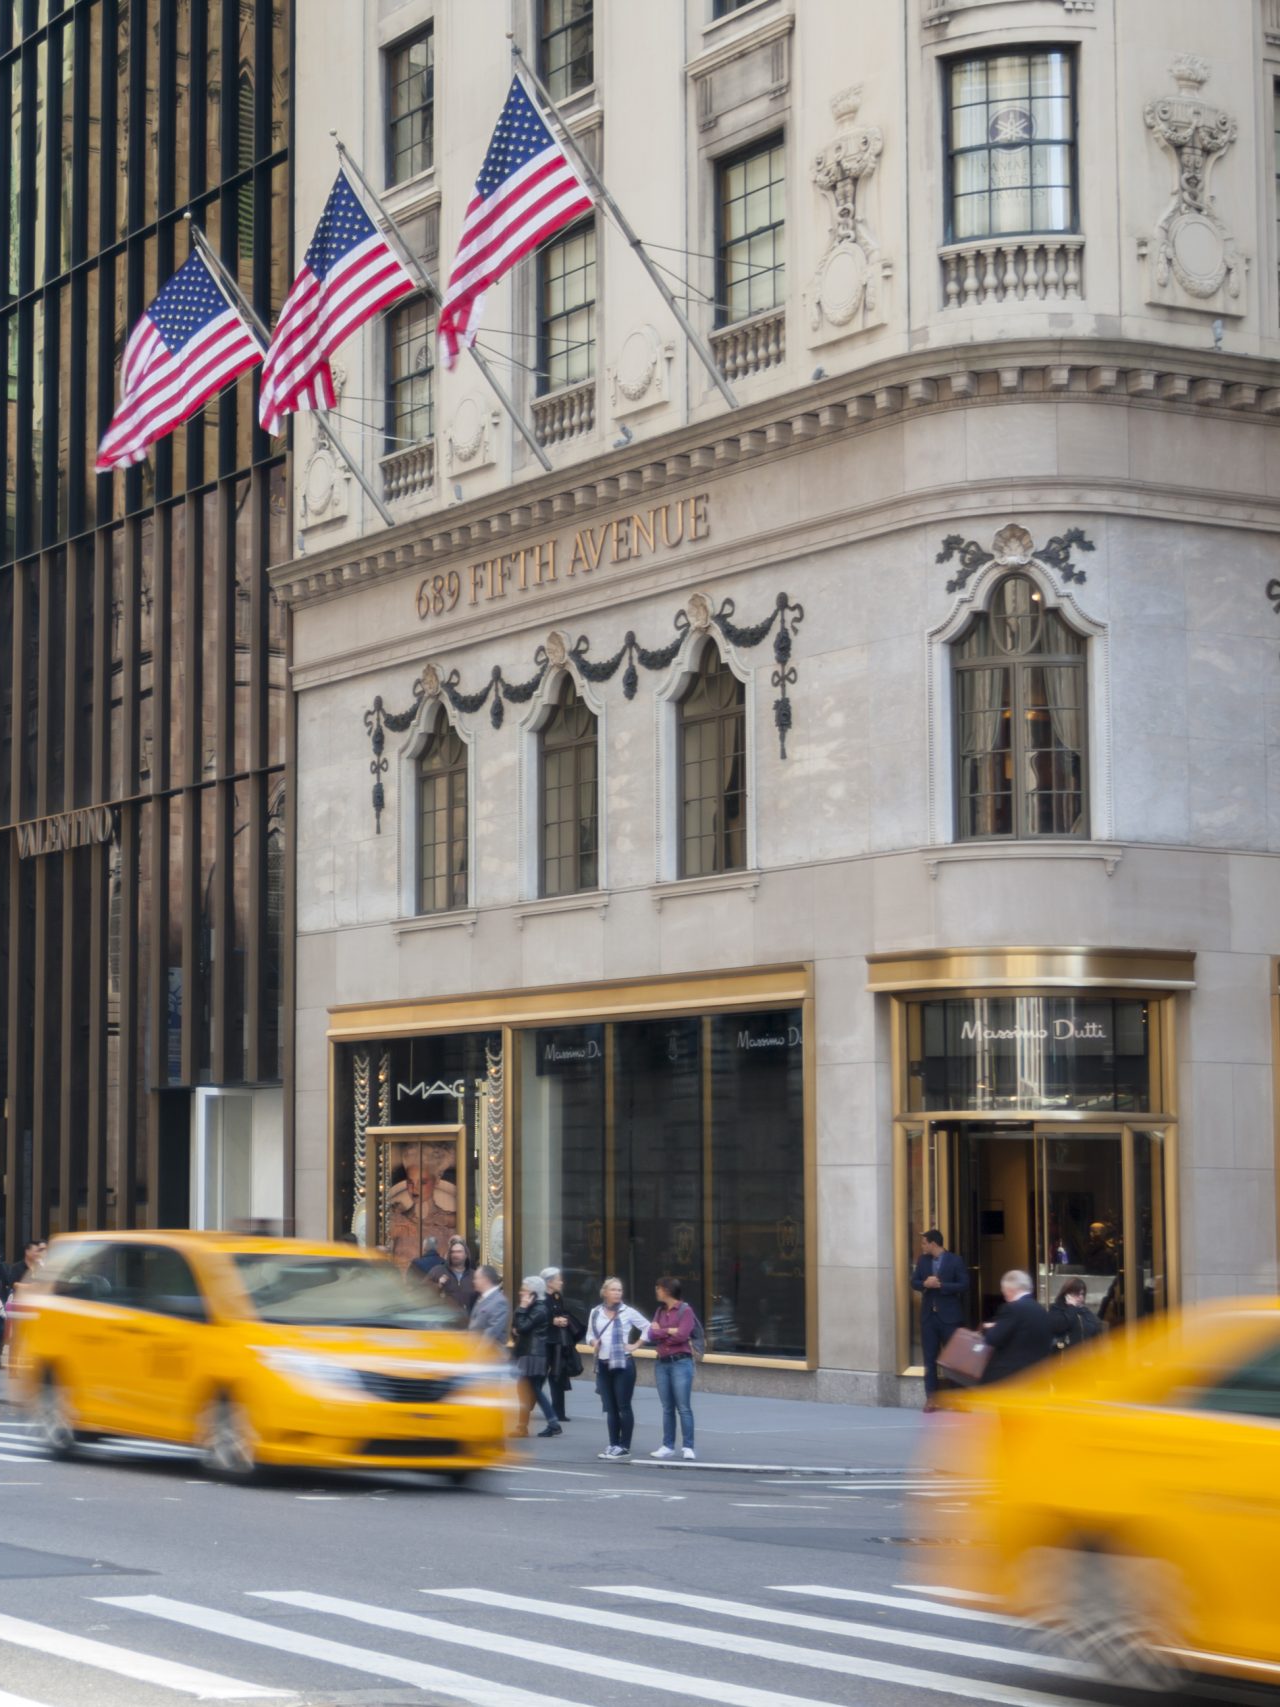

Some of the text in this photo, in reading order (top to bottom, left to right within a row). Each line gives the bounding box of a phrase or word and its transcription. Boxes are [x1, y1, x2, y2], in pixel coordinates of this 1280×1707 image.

[415, 493, 711, 621] 689 FIFTH AVENUE
[16, 807, 112, 860] VALENTINO
[736, 1030, 785, 1050] Massimo
[960, 1019, 1107, 1042] Massimo Dutti
[544, 1043, 586, 1061] Massimo
